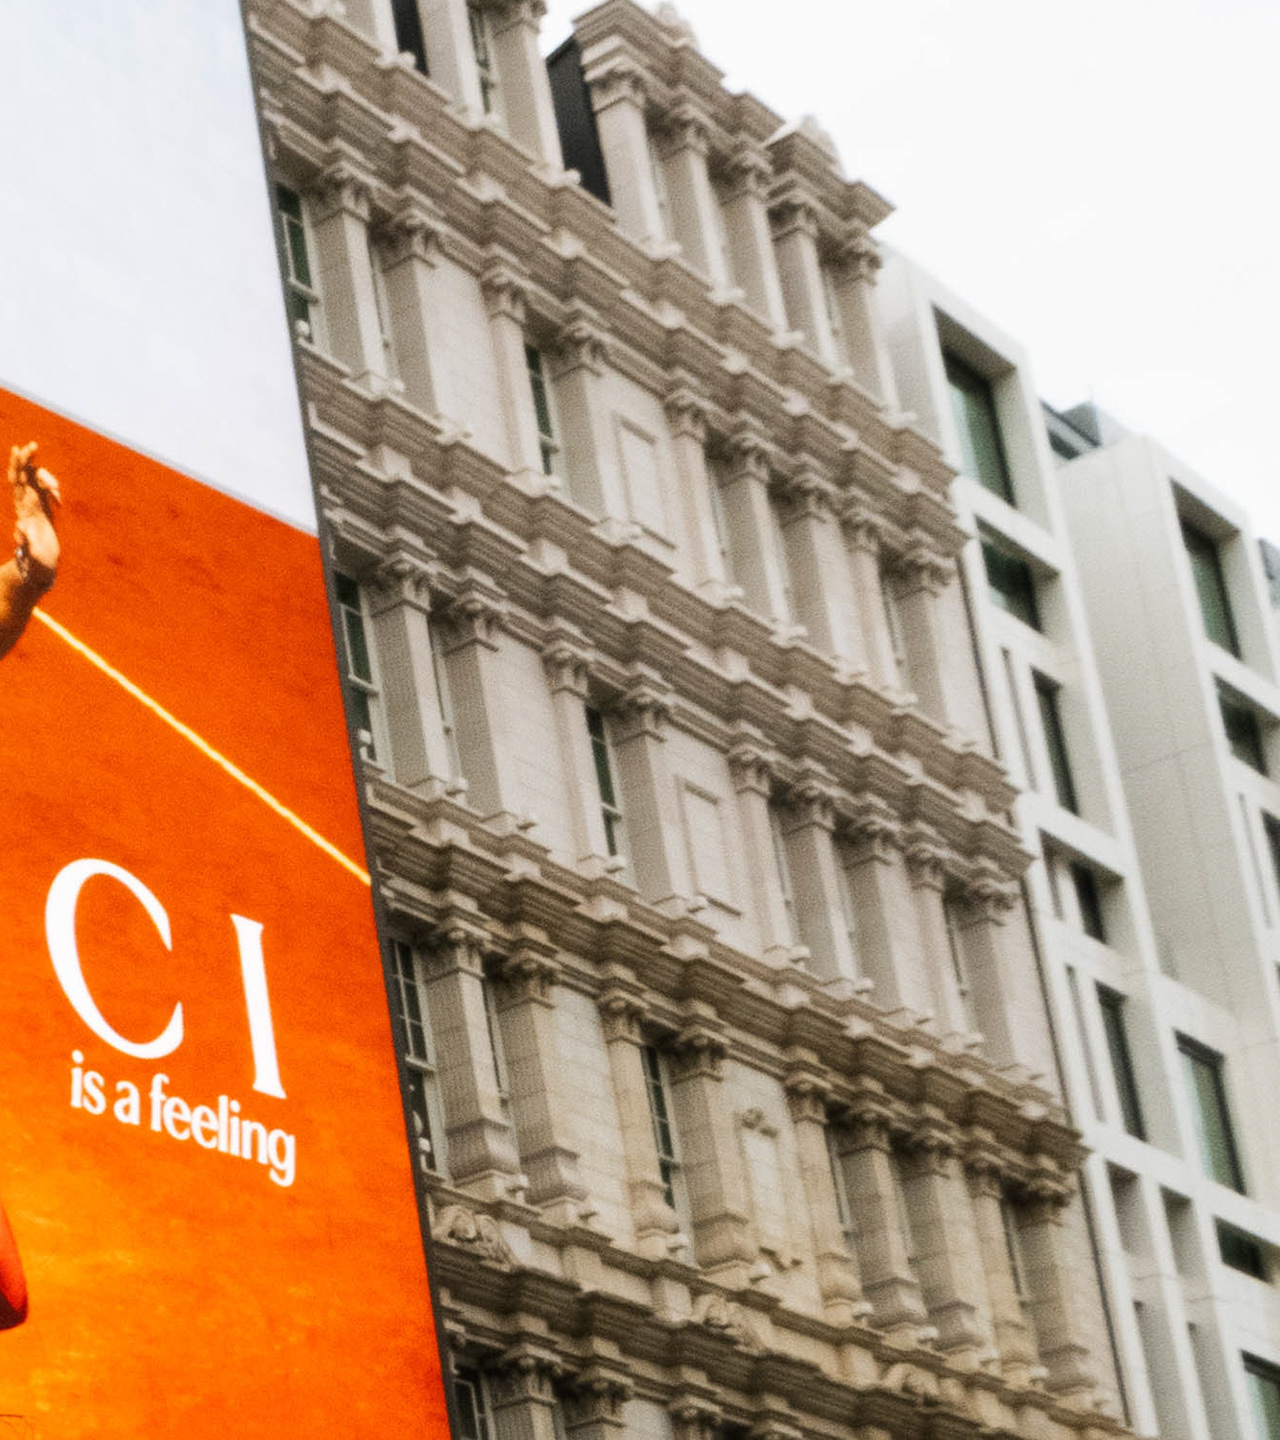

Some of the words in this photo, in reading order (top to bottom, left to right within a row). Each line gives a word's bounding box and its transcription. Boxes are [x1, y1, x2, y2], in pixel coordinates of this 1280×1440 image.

[71, 1049, 106, 1115] is
[113, 1081, 140, 1125] a
[149, 1073, 296, 1187] feeling
